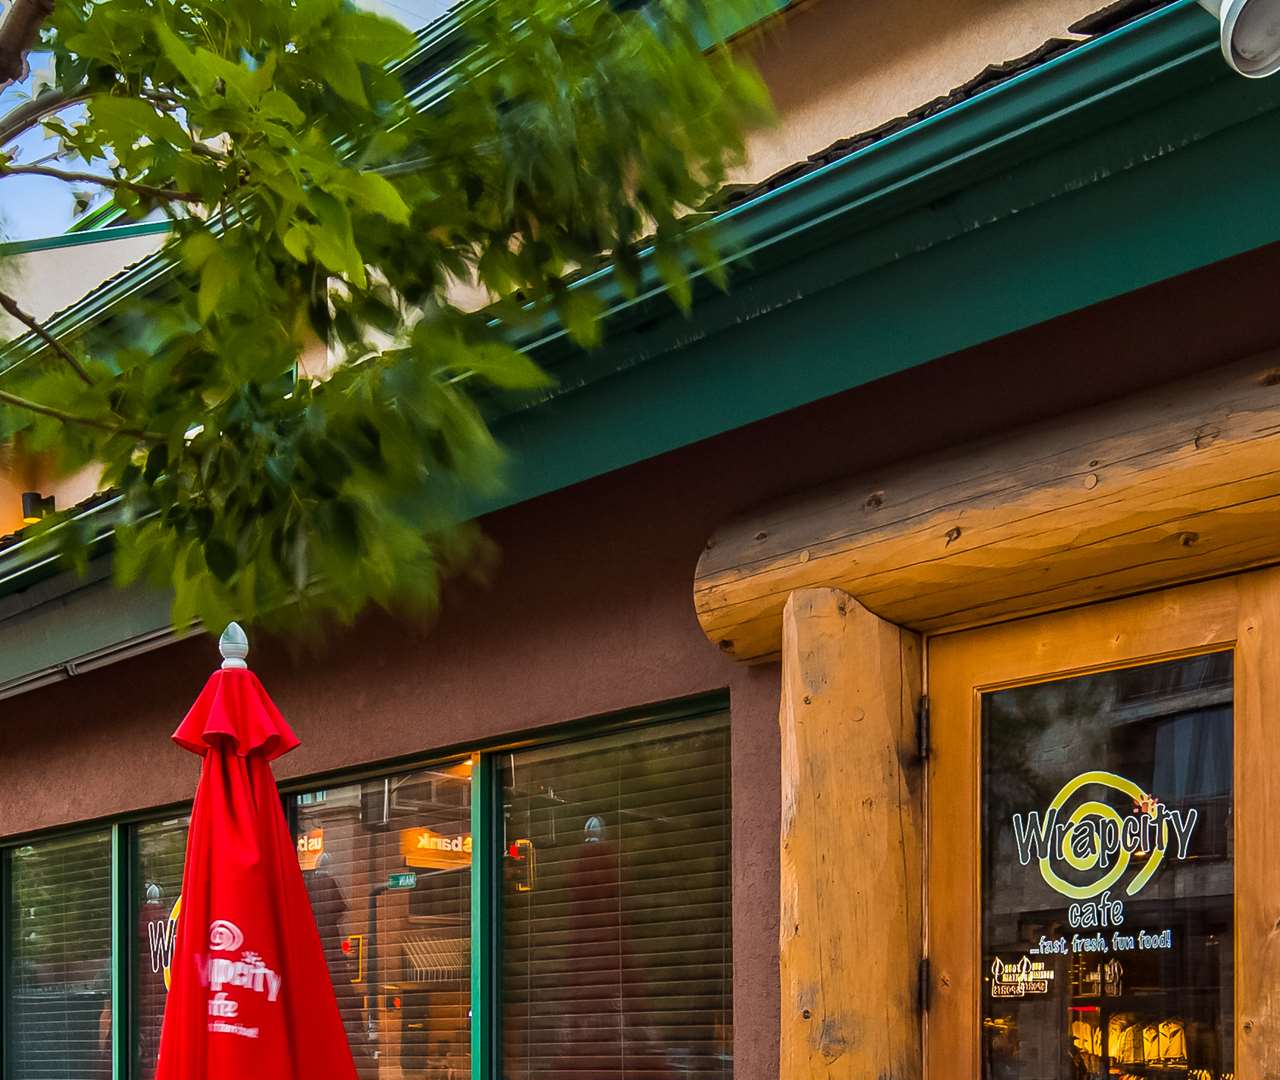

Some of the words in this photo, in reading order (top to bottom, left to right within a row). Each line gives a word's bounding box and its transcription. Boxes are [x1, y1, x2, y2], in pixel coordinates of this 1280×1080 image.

[1013, 803, 1198, 868] Wrapcity
[1068, 891, 1124, 928] cafe
[1072, 932, 1109, 953] fresh,
[1113, 932, 1135, 950] fun
[1138, 929, 1172, 949] food!
